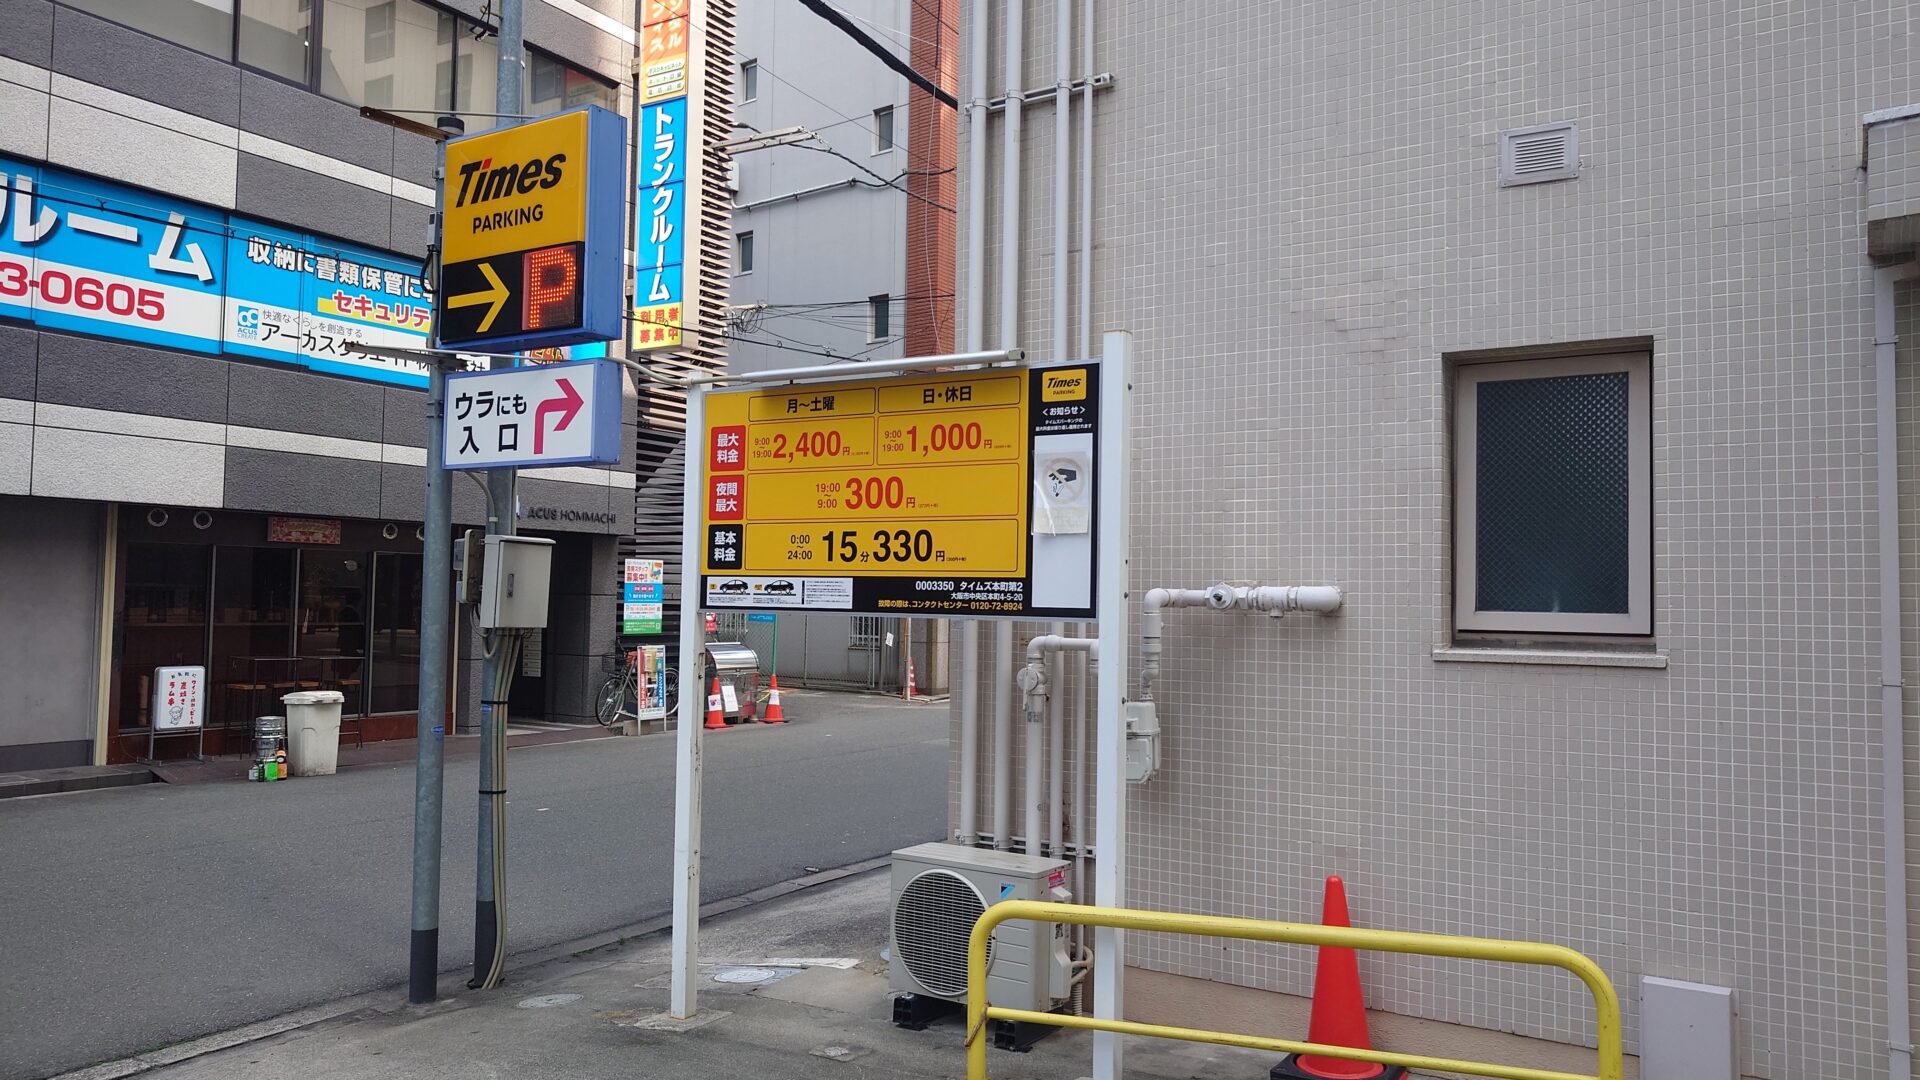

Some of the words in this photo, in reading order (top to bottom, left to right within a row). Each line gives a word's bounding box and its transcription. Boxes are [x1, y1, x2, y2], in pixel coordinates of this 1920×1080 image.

[455, 153, 567, 209] Times
[649, 106, 675, 302] トランクルーム
[472, 204, 544, 235] PARKING
[0, 261, 165, 322] 3-0605
[529, 249, 576, 329] P
[237, 327, 258, 336] ACUS
[1047, 377, 1082, 389] Times
[923, 385, 972, 405] 日・休日
[455, 390, 527, 420] ウラにも
[717, 433, 739, 447] 最大
[754, 437, 770, 446] 9:00
[884, 430, 902, 439] 9:00
[752, 450, 772, 459] 19:00
[882, 443, 904, 452] 19:00
[716, 449, 739, 464] 料金
[715, 482, 738, 496] 夜間
[815, 482, 841, 493] 19:00
[715, 498, 738, 513] 最大
[817, 499, 838, 509] 9:00
[527, 507, 557, 520] ACUS
[560, 510, 616, 524] HOMMACHI
[714, 531, 737, 546] 基本
[790, 534, 811, 545] 0:00
[713, 547, 737, 562] 料金
[787, 550, 813, 560] 24:00
[915, 580, 955, 591] 0003350
[959, 581, 1024, 592] タイムズ本町第2
[950, 592, 1024, 601] 大阪市中央区本町4-5-20
[970, 602, 1024, 611] 0120-72-8924
